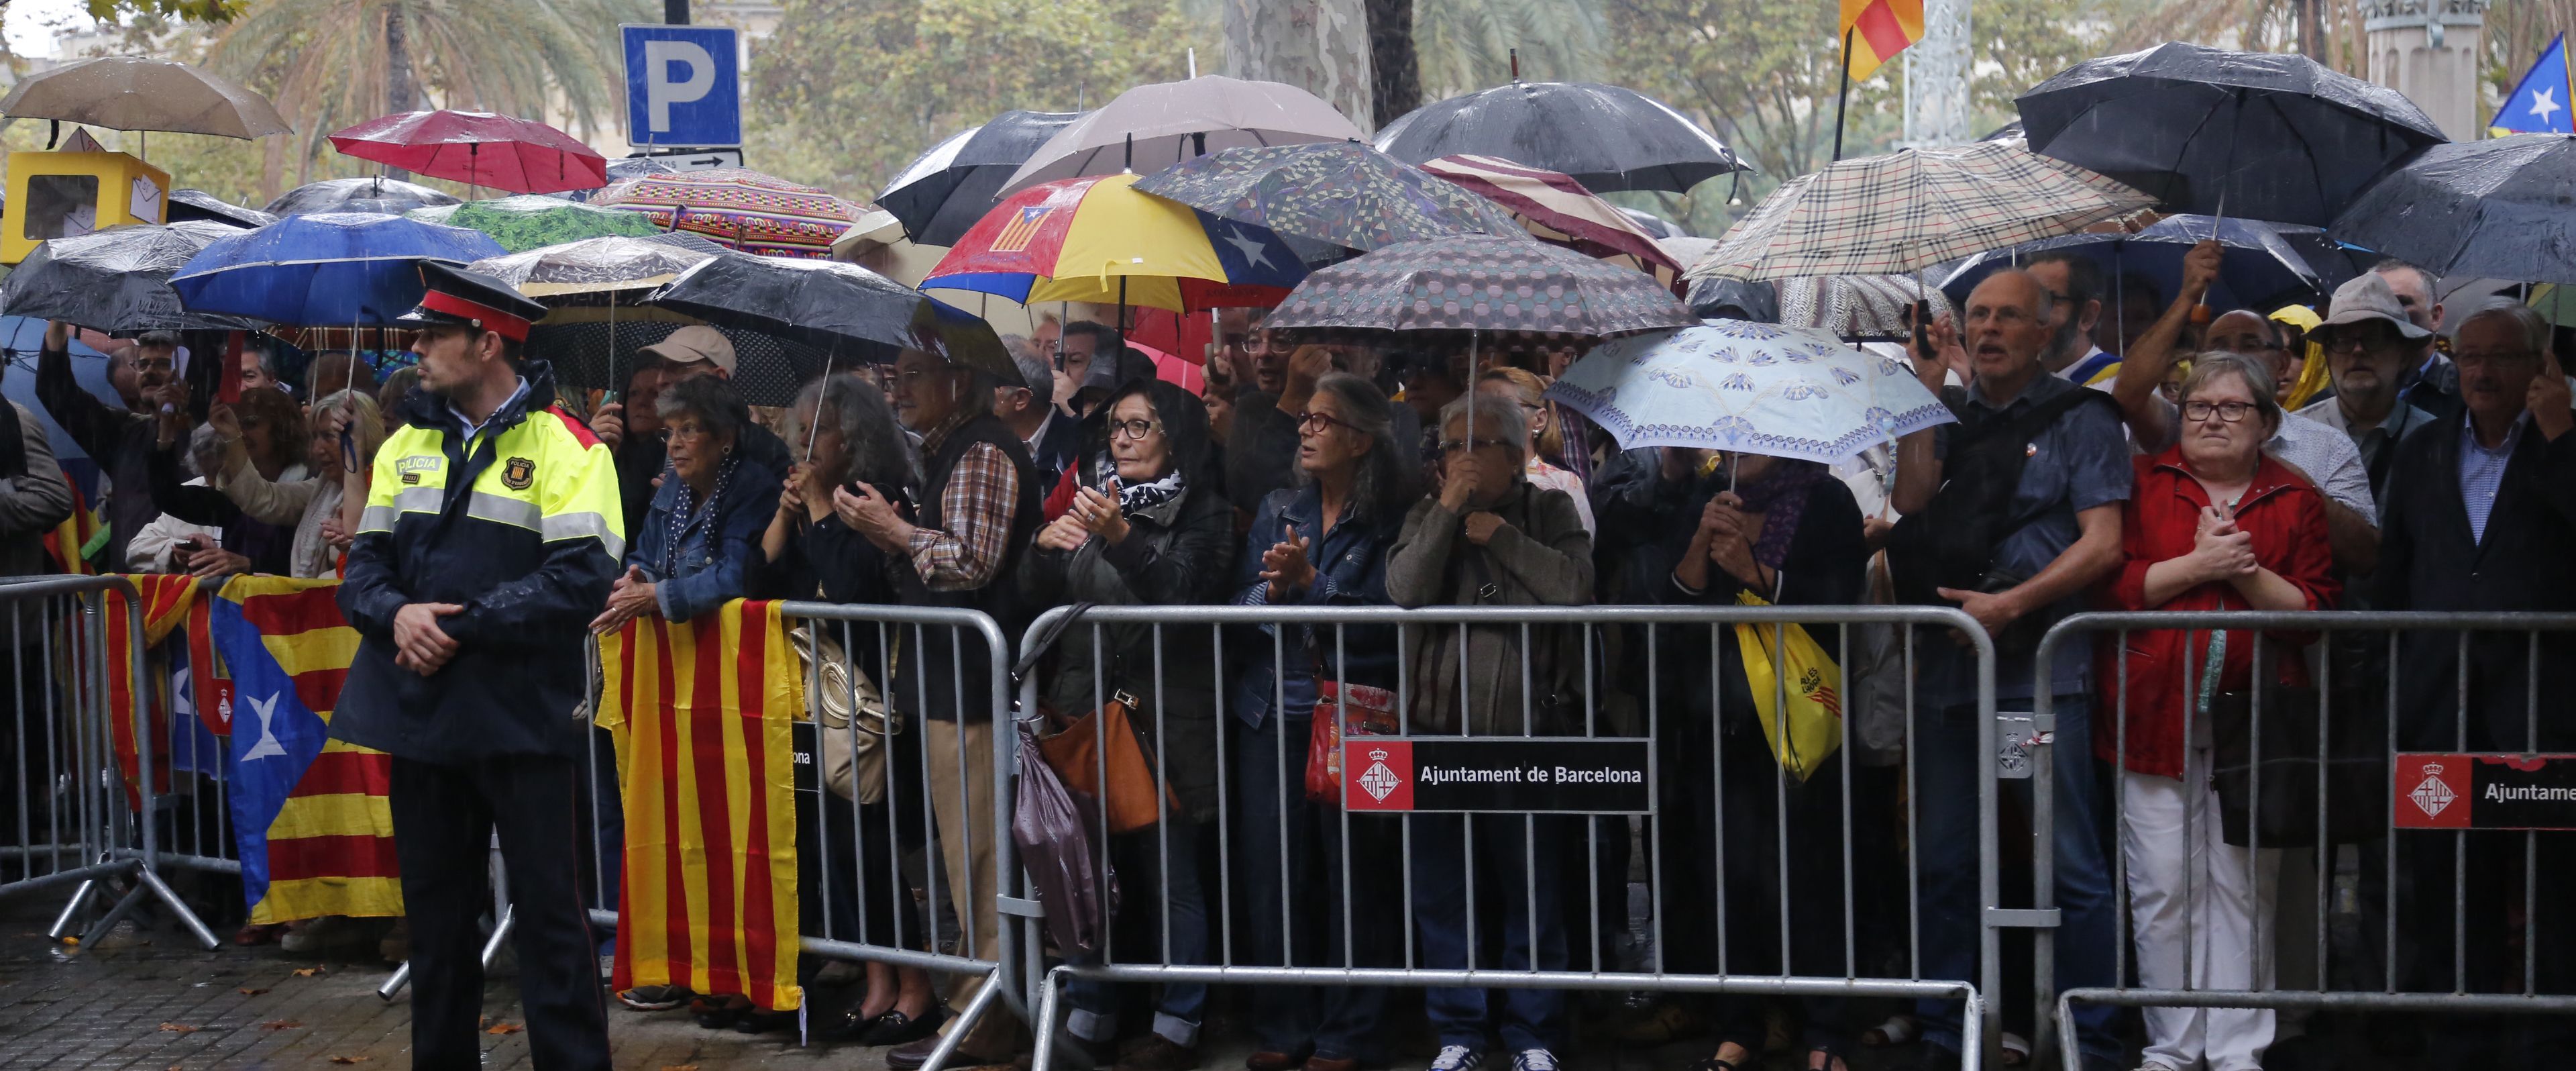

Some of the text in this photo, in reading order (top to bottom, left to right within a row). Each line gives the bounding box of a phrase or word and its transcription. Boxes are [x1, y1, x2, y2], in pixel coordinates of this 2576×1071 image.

[645, 40, 716, 132] P
[1420, 766, 1642, 786] Ajuntament de Barcelona
